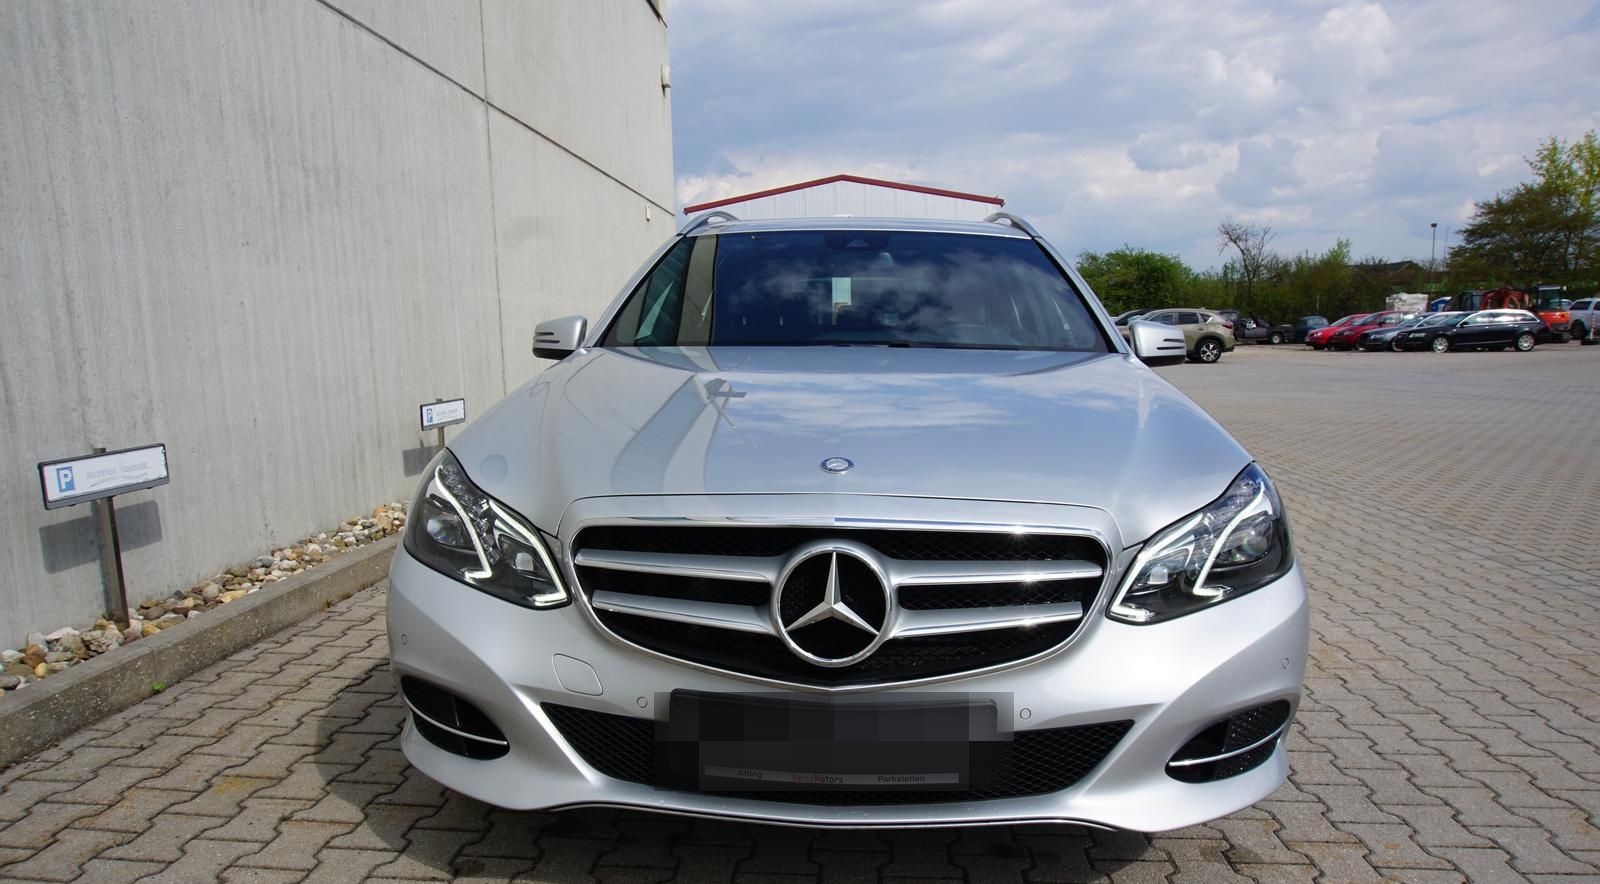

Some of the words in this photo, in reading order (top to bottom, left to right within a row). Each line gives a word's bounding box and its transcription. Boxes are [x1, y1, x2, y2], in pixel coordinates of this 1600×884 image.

[59, 469, 72, 489] P
[737, 769, 762, 780] Atting
[877, 774, 926, 784] Parkstetten
